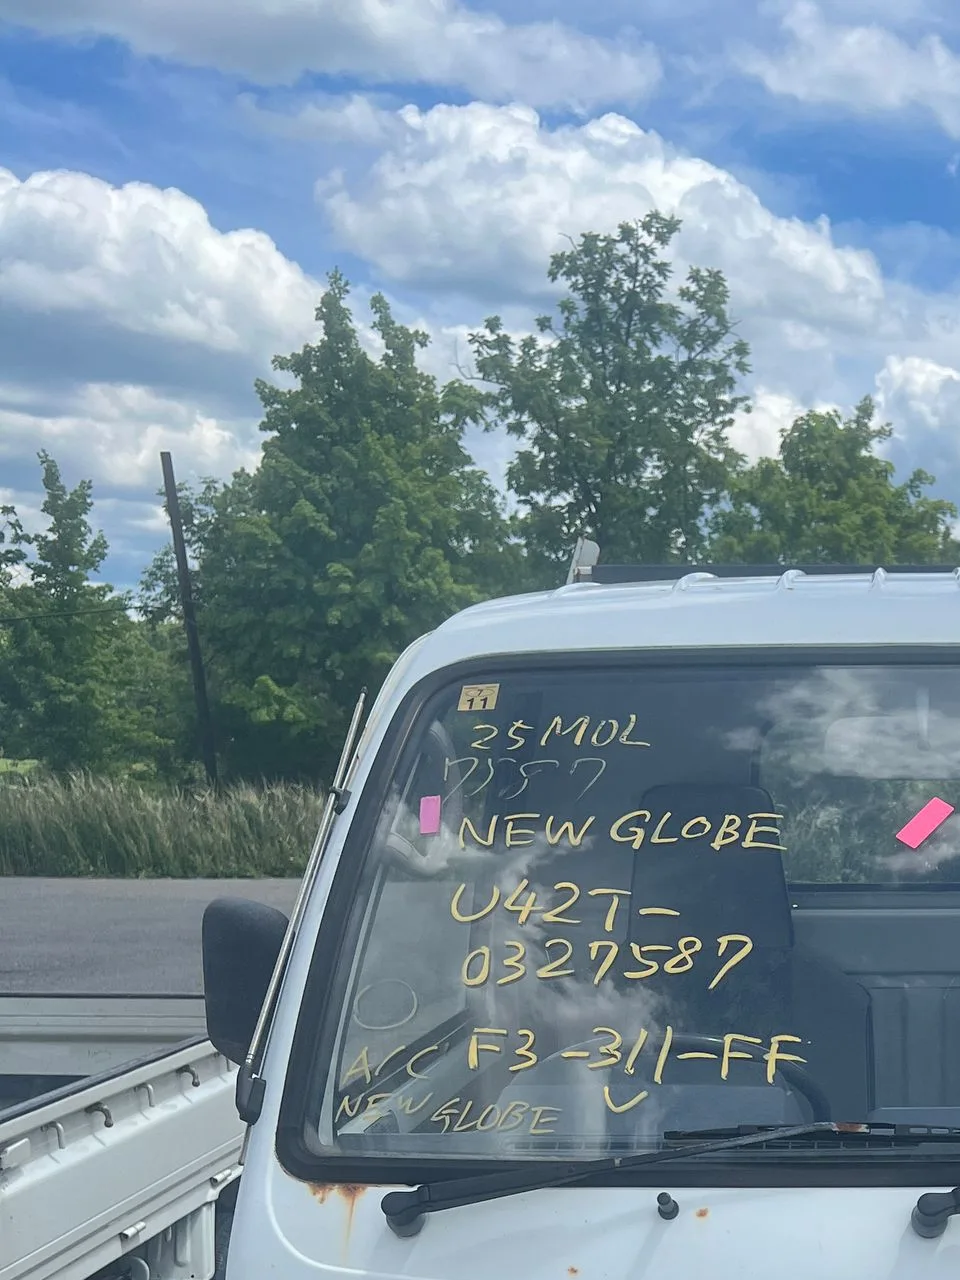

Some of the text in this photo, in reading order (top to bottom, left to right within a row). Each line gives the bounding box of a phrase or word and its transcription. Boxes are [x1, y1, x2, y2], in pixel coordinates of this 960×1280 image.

[467, 697, 488, 710] 11
[477, 689, 484, 697] 7
[458, 809, 788, 850] NEW GLOBE
[461, 933, 753, 991] 0327587
[341, 1045, 438, 1085] A/C
[335, 1092, 562, 1135] NEW GLOBE
